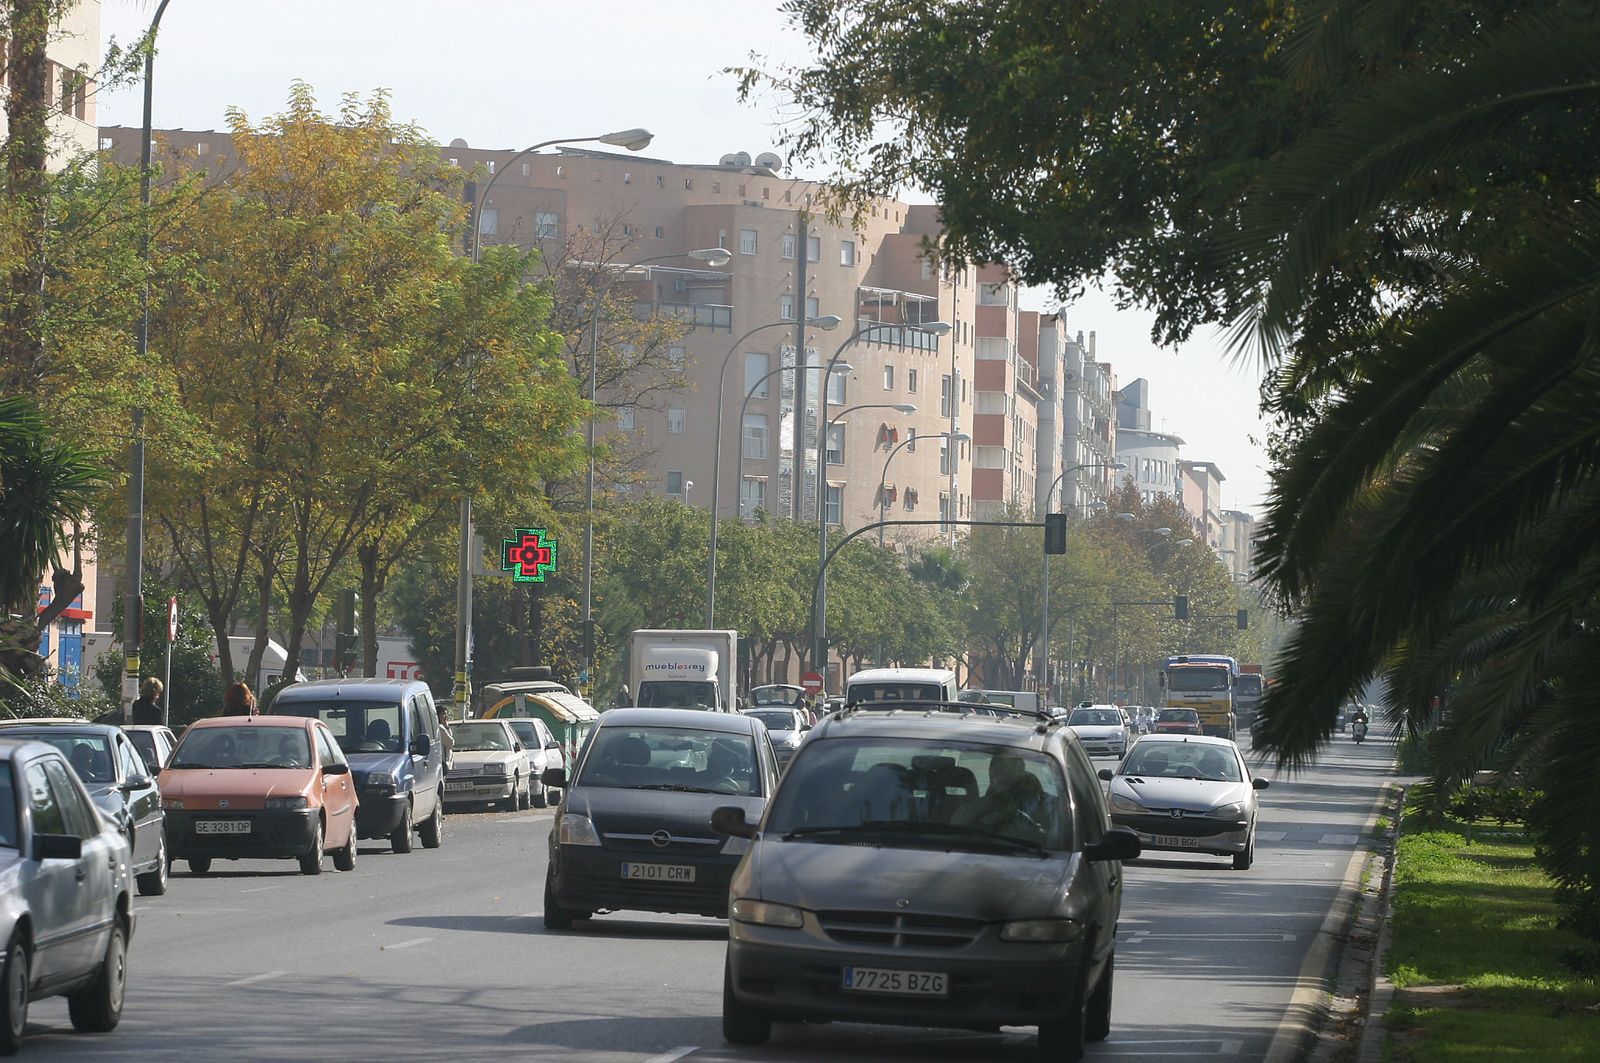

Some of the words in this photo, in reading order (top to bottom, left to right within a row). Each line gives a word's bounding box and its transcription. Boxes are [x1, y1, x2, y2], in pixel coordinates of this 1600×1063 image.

[645, 662, 705, 671] mueblesrey
[632, 865, 662, 878] 2101
[667, 867, 691, 879] CRW
[856, 971, 901, 990] 7725
[908, 974, 943, 992] BZG
